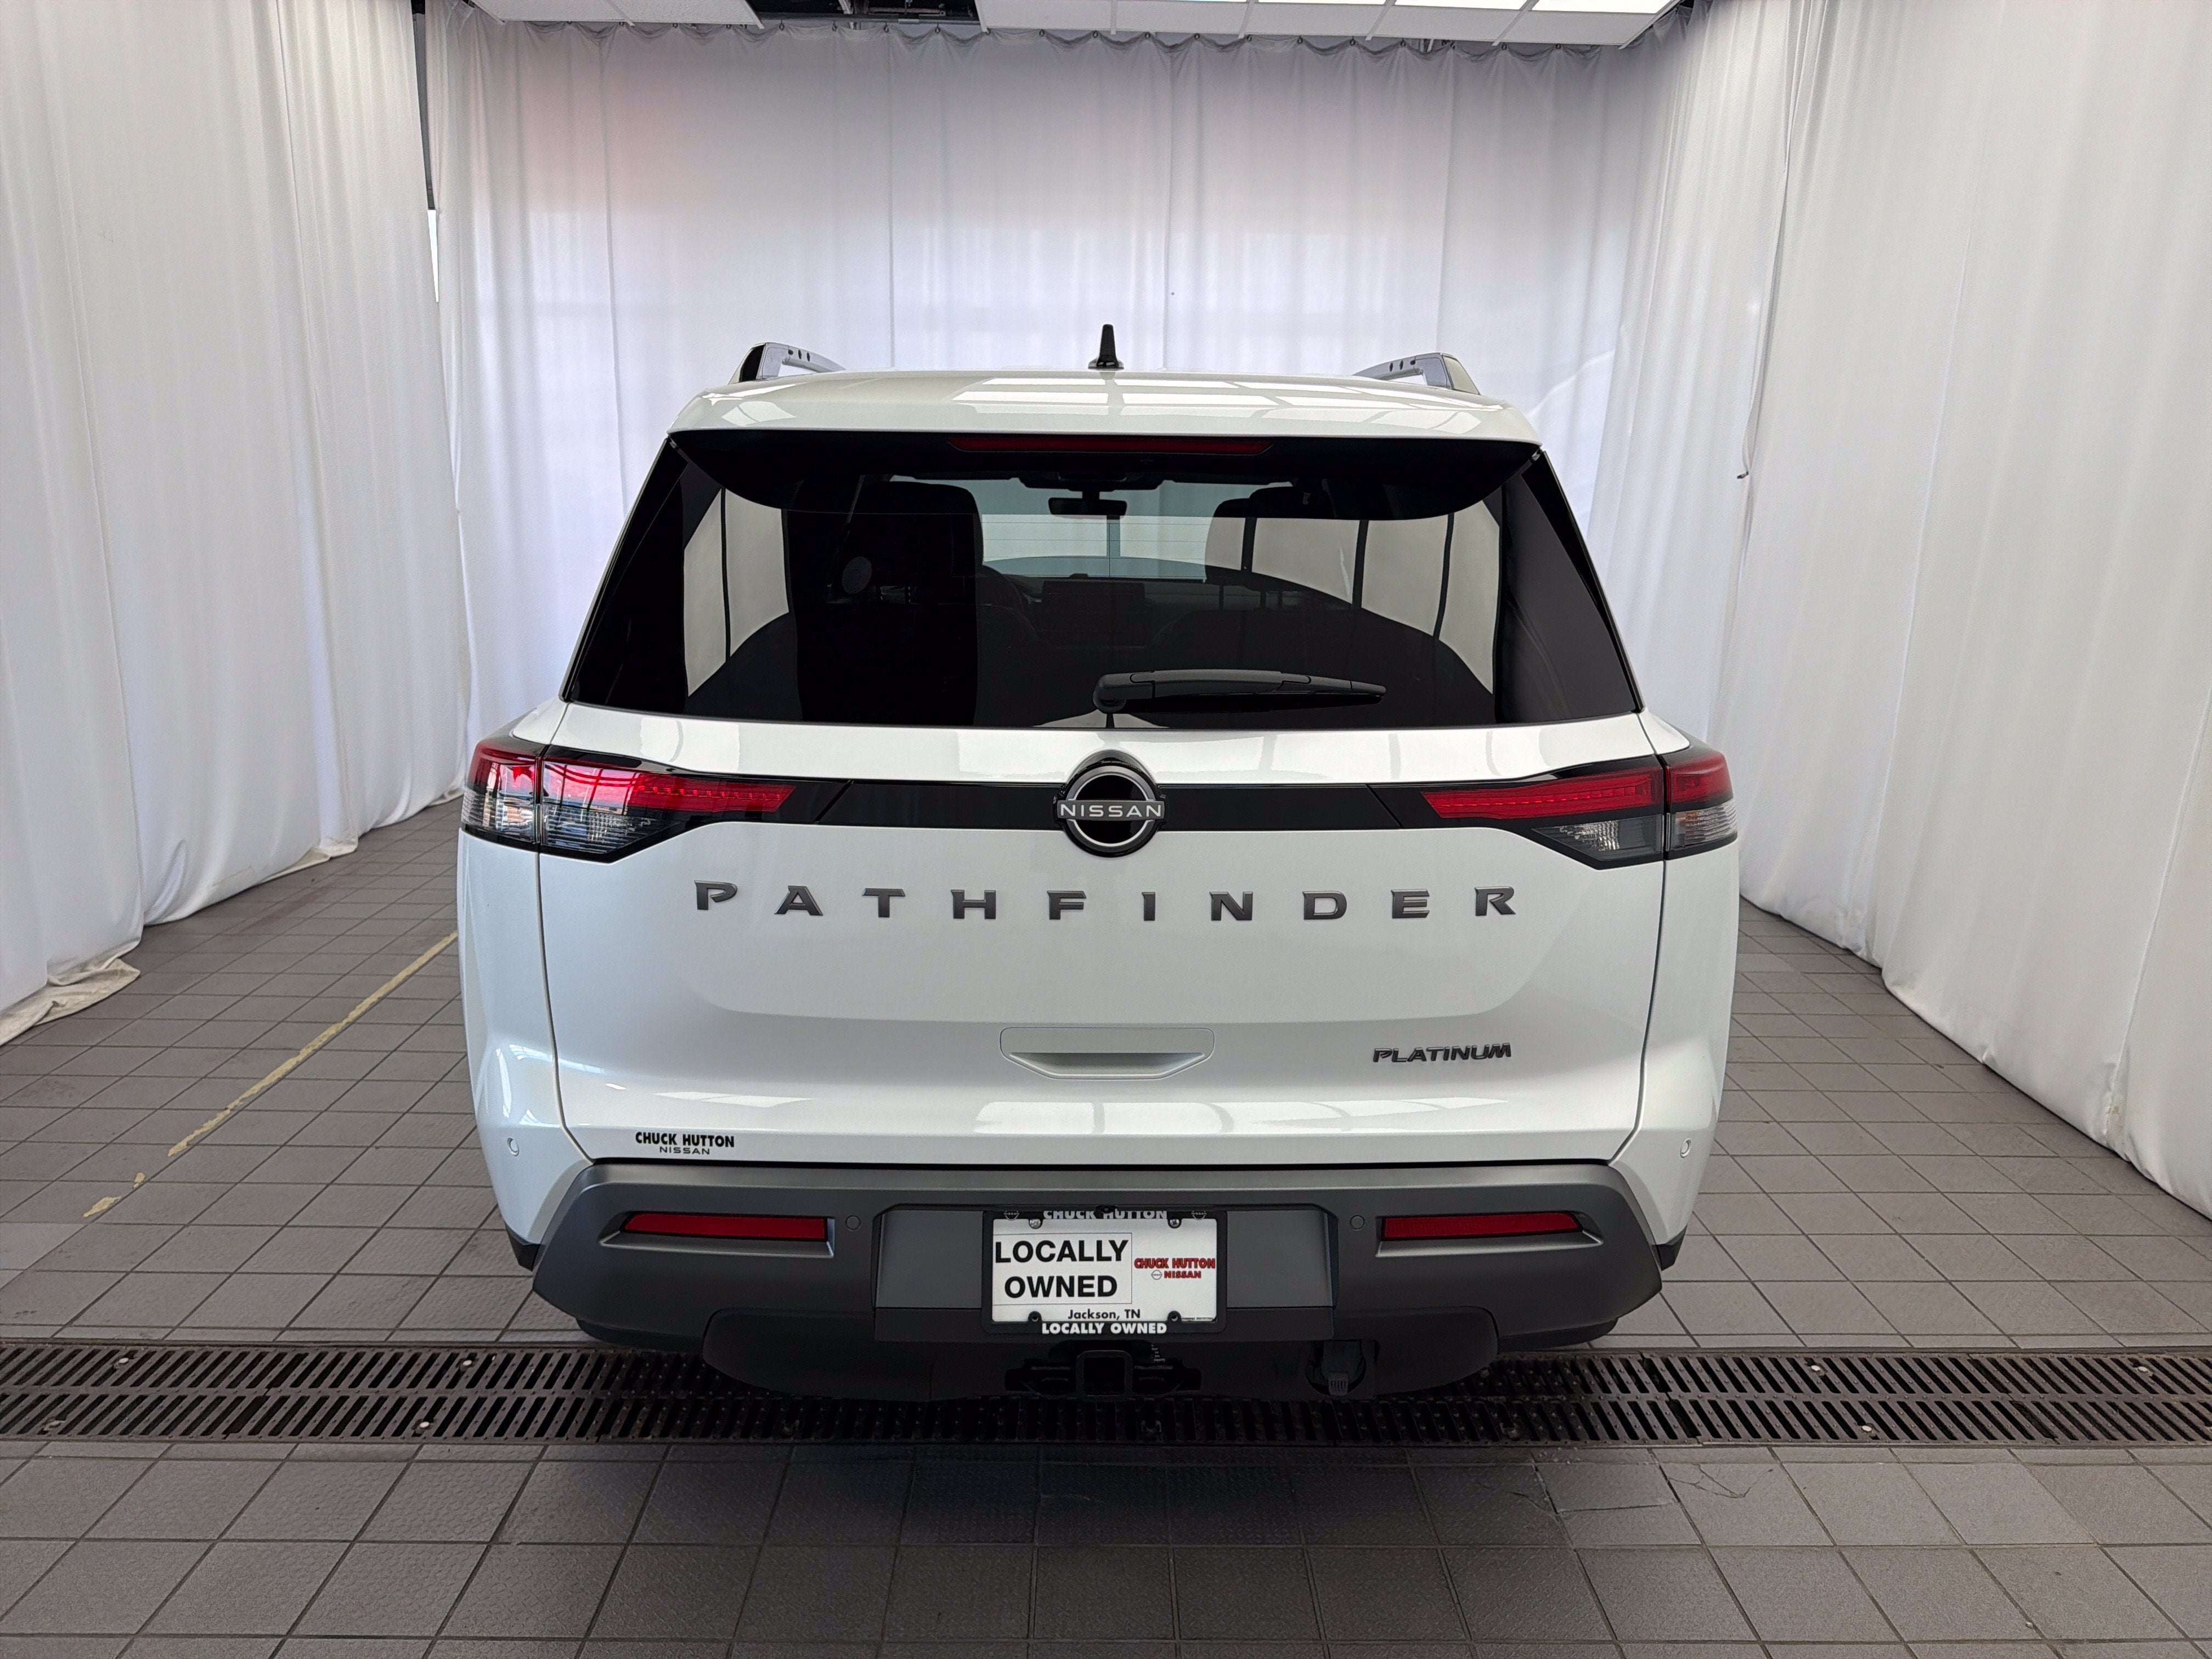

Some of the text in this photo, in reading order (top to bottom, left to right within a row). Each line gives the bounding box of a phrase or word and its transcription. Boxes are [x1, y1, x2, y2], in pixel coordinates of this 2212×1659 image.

[1060, 804, 1161, 817] NISSAN
[693, 879, 1516, 921] PATHFINDER
[1373, 1042, 1511, 1063] PLATINUM
[635, 1131, 735, 1148] CHUCK HUTTON
[659, 1146, 710, 1155] NISSAN
[1043, 1208, 1167, 1219] CHUCK HUTTON
[995, 1239, 1129, 1263] LOCALLY
[1134, 1258, 1216, 1269] CHUCK HUTTON
[1164, 1271, 1201, 1279] NISSAN
[1005, 1275, 1118, 1299] OWNED
[1068, 1308, 1141, 1321] Jackson, TN
[1042, 1322, 1167, 1334] LOCALLY OWNED
